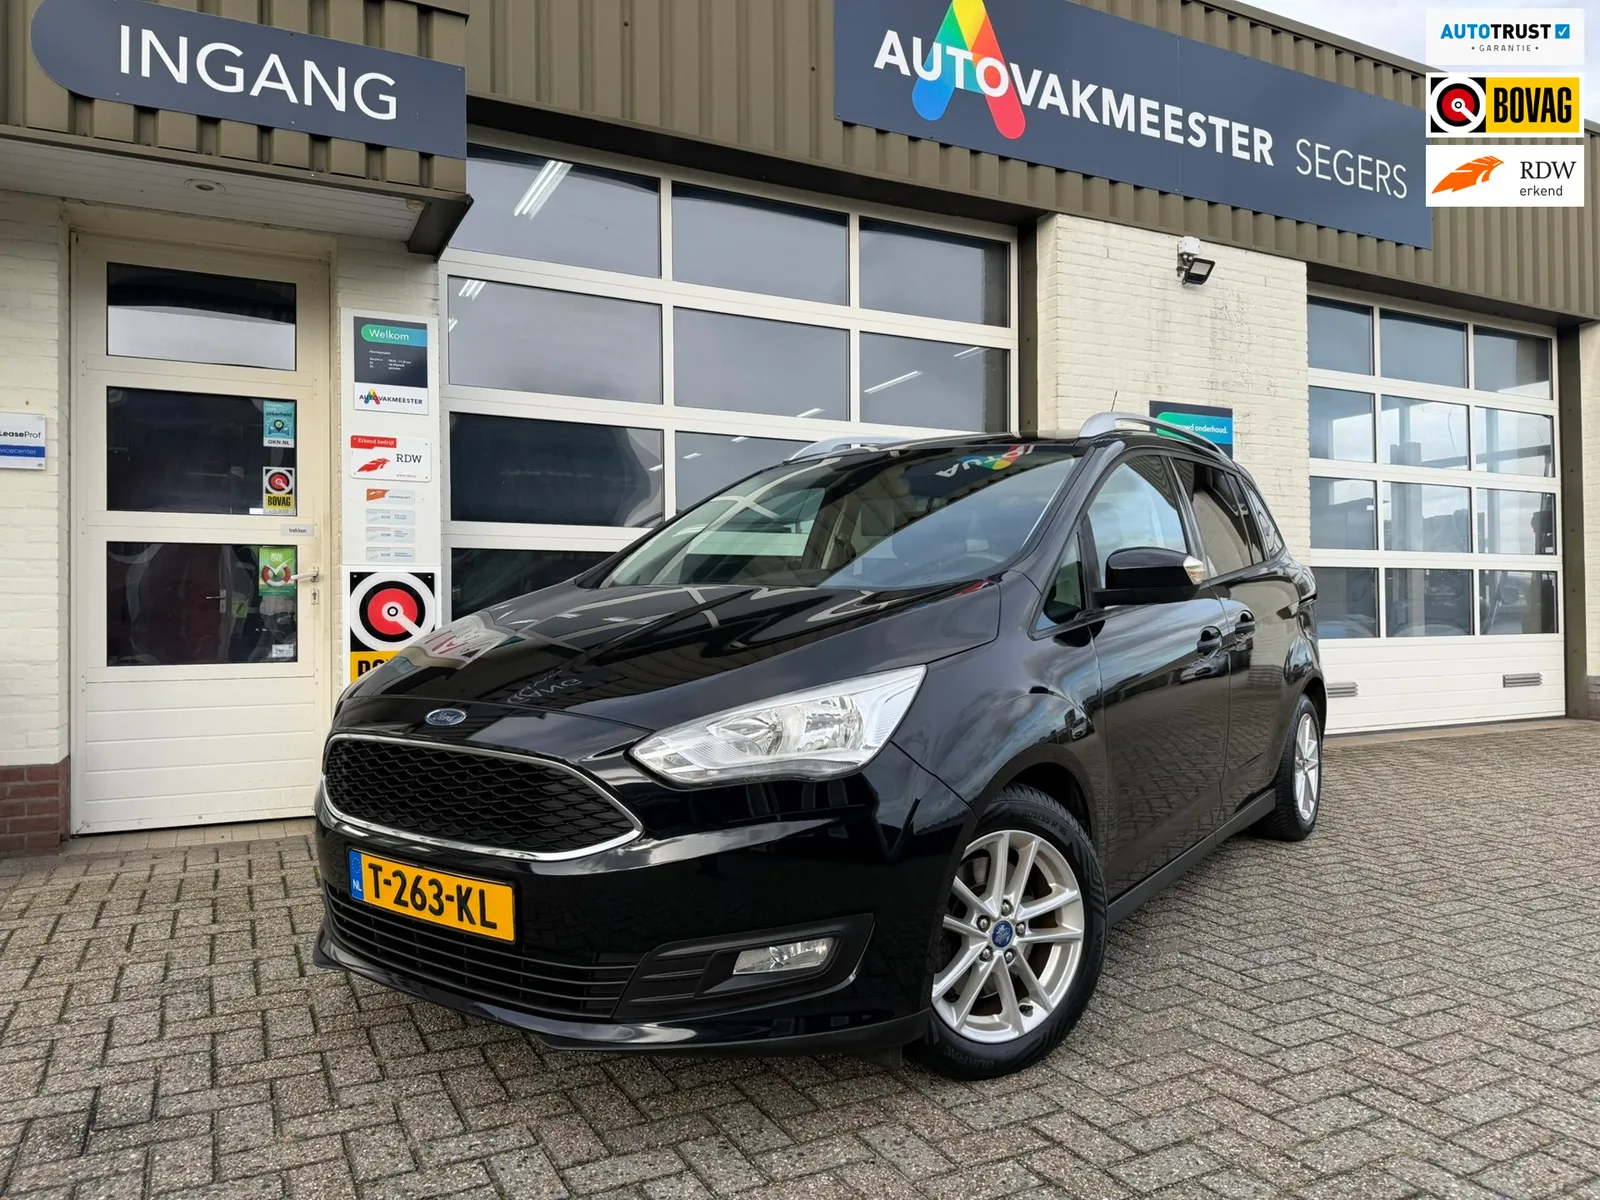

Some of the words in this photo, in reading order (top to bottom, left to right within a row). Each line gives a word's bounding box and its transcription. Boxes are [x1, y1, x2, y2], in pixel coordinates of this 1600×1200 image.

[119, 24, 398, 121] INGANG
[873, 29, 1274, 167] AUTOVAKMEESTER
[1295, 138, 1408, 199] SEGERS
[368, 328, 410, 341] Welkom
[359, 394, 423, 405] AUTOVAKMEESTER
[357, 437, 377, 445] Erkend
[377, 438, 395, 447] bedrijf
[0, 447, 37, 455] vicecenter
[396, 453, 422, 464] RDW
[267, 496, 291, 507] BOVAG
[352, 878, 363, 892] NL
[368, 862, 498, 930] T-263-KL
